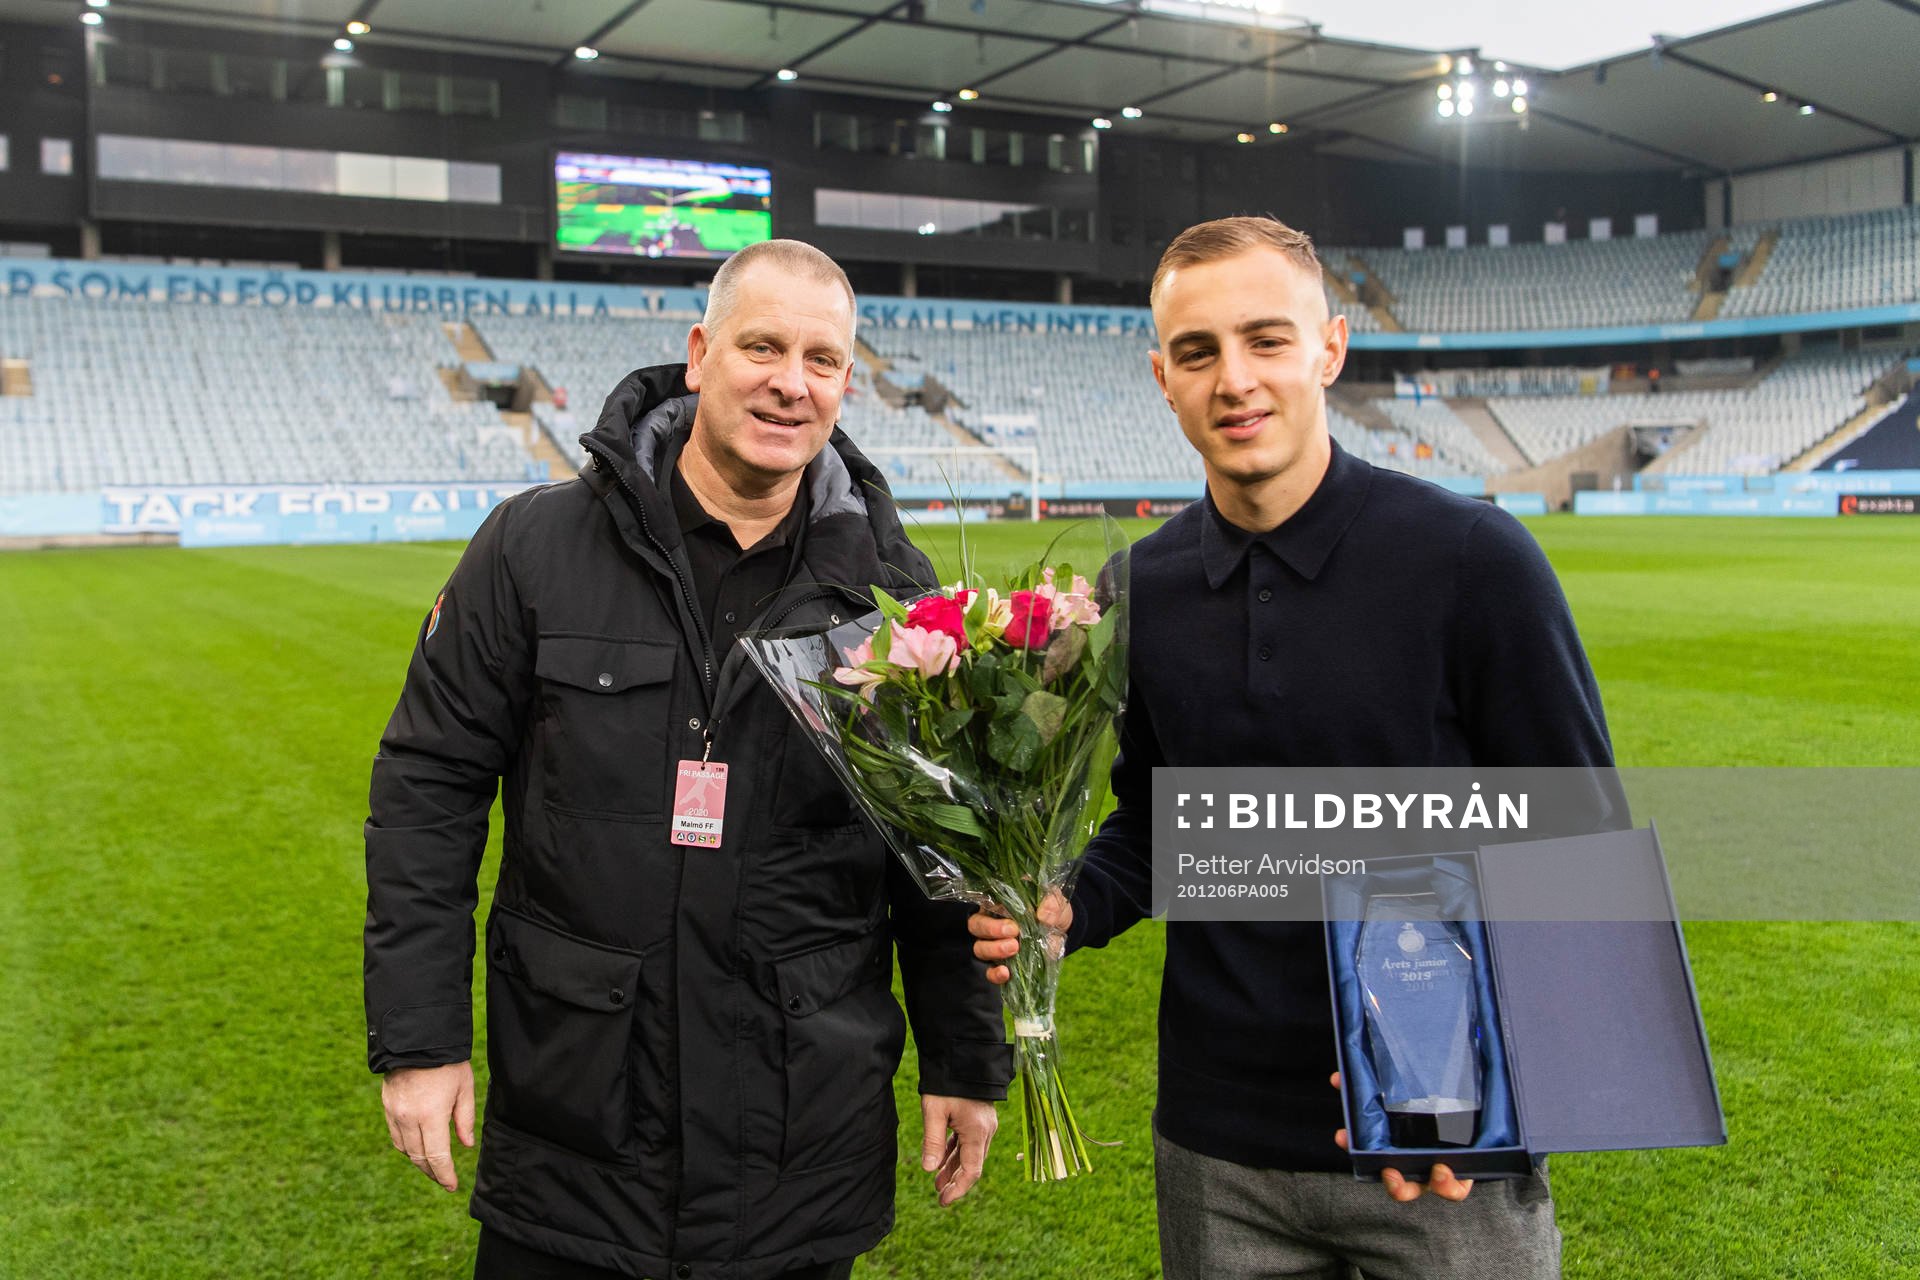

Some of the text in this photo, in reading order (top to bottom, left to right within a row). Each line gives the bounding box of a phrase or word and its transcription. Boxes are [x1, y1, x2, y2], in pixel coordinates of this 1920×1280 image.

[52, 269, 149, 301] SOM
[166, 274, 221, 304] EN
[862, 304, 954, 329] SKALL
[972, 309, 1036, 331] MEN
[1047, 312, 1110, 334] INTE
[688, 808, 709, 817] 2020
[680, 820, 714, 830] Malmö FF
[1382, 957, 1447, 970] Årets junior
